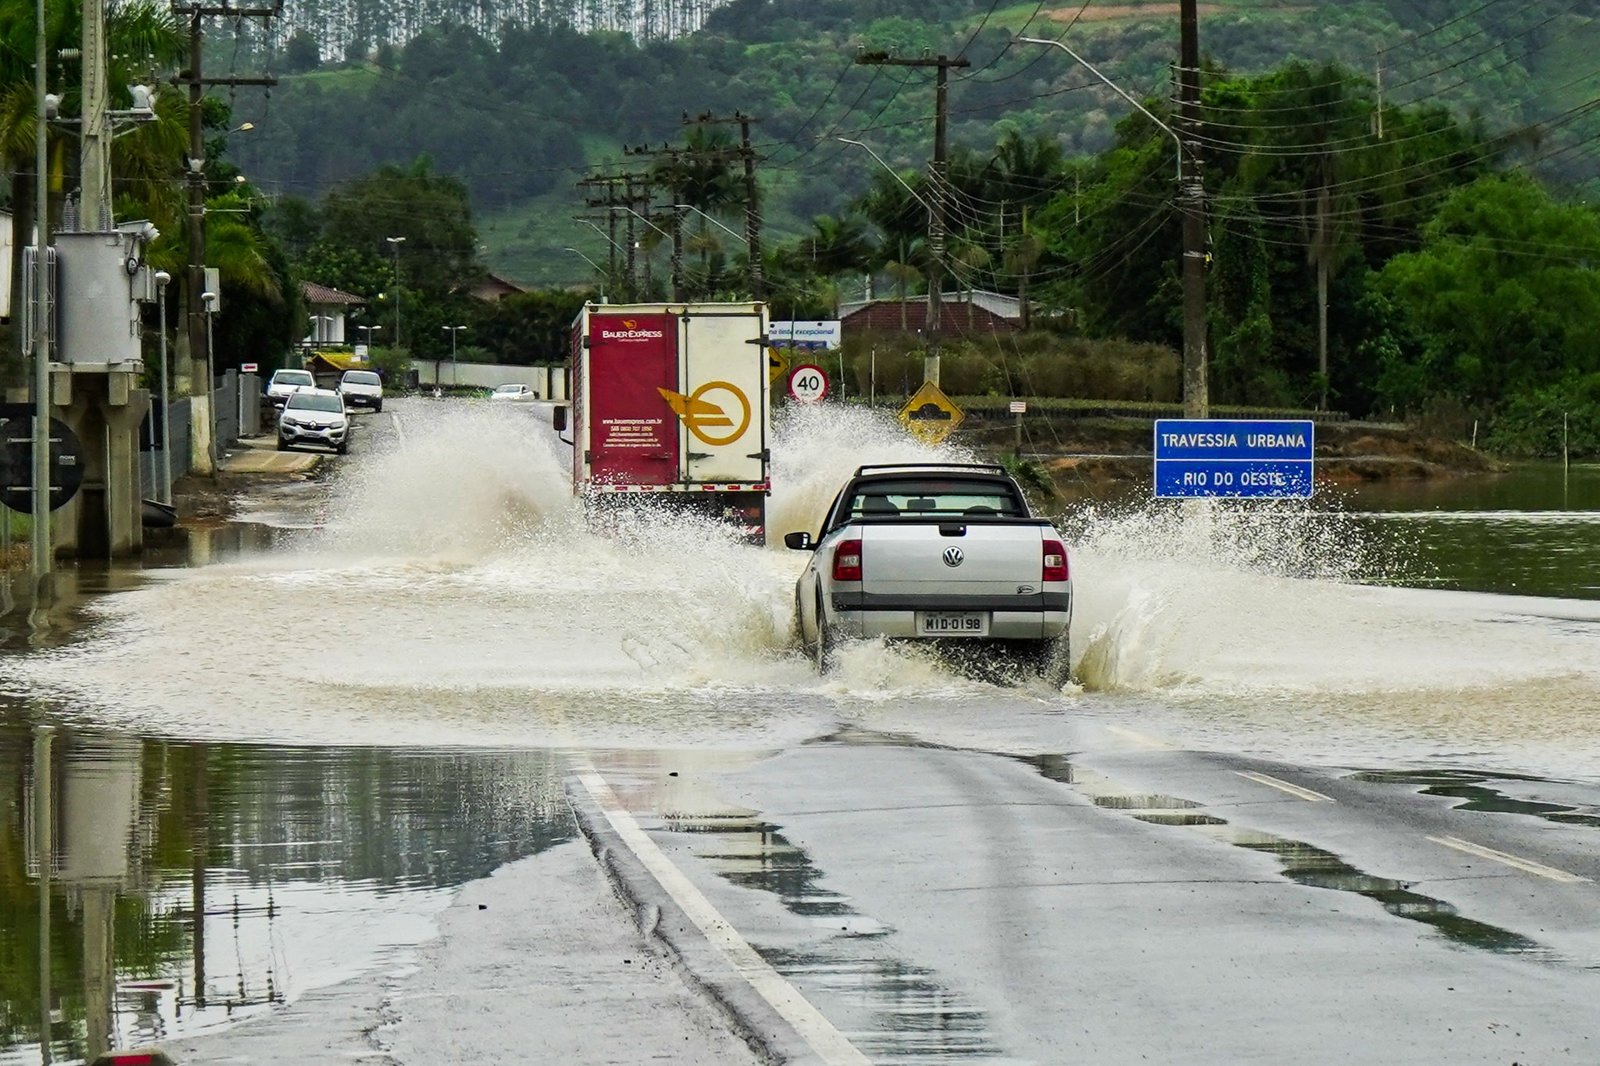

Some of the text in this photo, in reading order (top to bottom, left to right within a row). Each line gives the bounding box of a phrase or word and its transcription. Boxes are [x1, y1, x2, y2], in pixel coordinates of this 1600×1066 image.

[602, 329, 663, 338] BAUER EXPRESS
[797, 376, 819, 390] 40
[1161, 433, 1306, 448] TRAVESSIA URBANA
[1184, 472, 1285, 486] RIO DO OESTE
